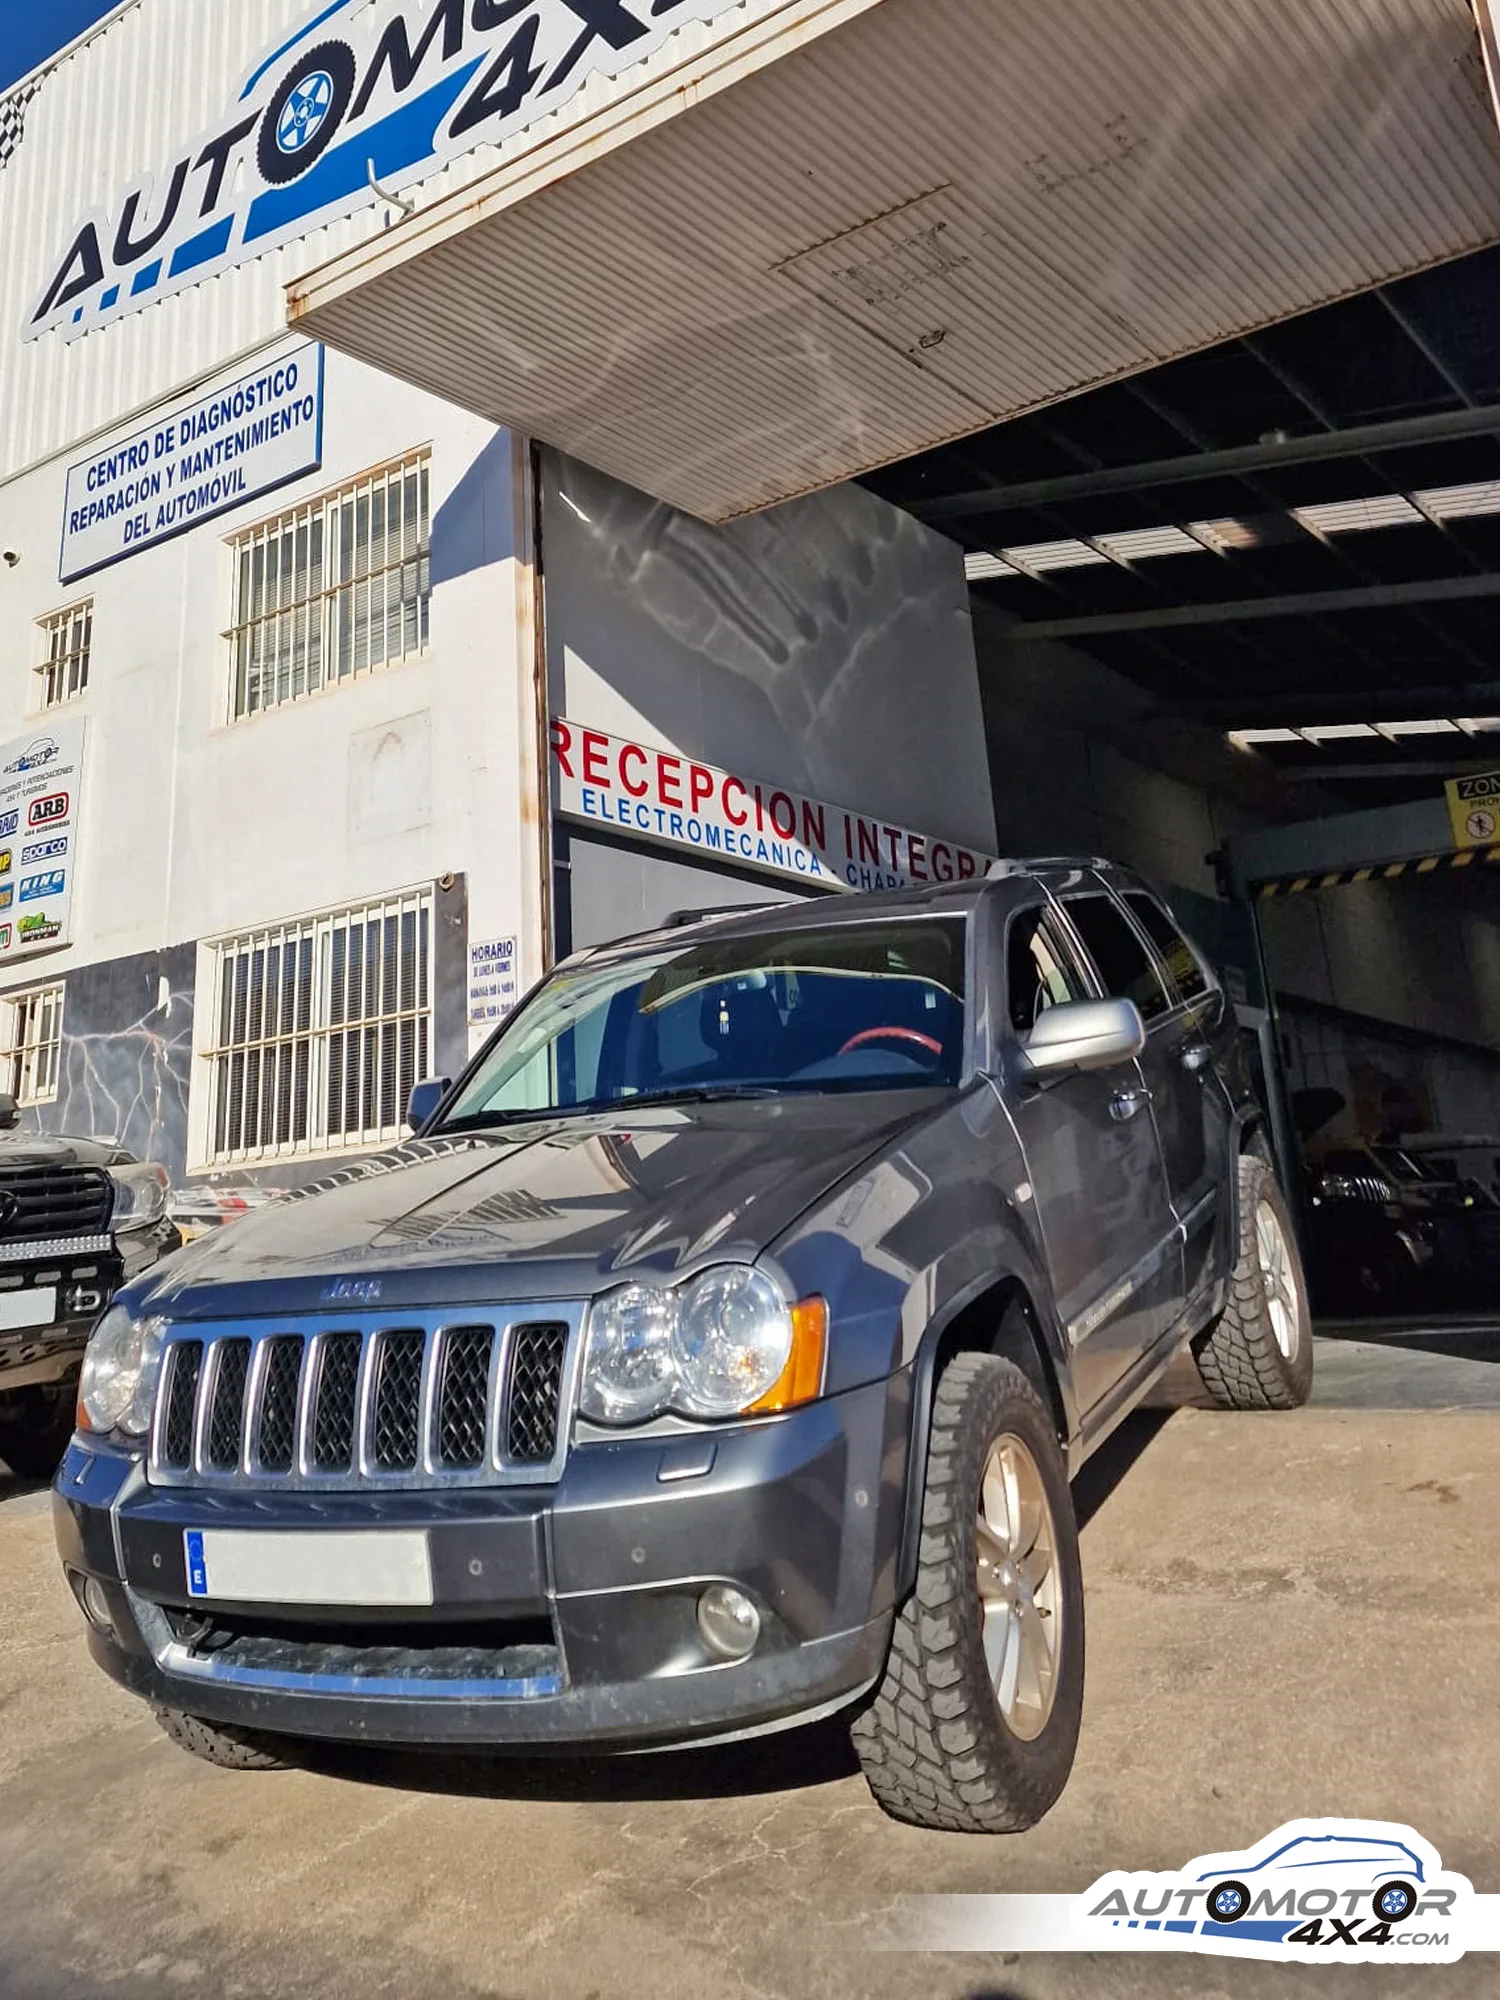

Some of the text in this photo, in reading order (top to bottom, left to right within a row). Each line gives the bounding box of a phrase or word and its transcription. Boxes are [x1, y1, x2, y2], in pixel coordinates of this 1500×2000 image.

[449, 0, 687, 139] 4X
[69, 394, 314, 535] REPARACIÓN Y MANTENIMIENTO
[86, 362, 298, 492] CENTRO DE DIAGNÓSTICO
[123, 466, 247, 544] DEL AUTOMÓVIL
[32, 797, 65, 821] ARB
[550, 720, 826, 851] RECEPCION
[582, 788, 822, 876] ELECTROMECANICA
[21, 870, 64, 891] KING
[472, 940, 513, 961] HORARIO
[194, 1569, 203, 1585] E
